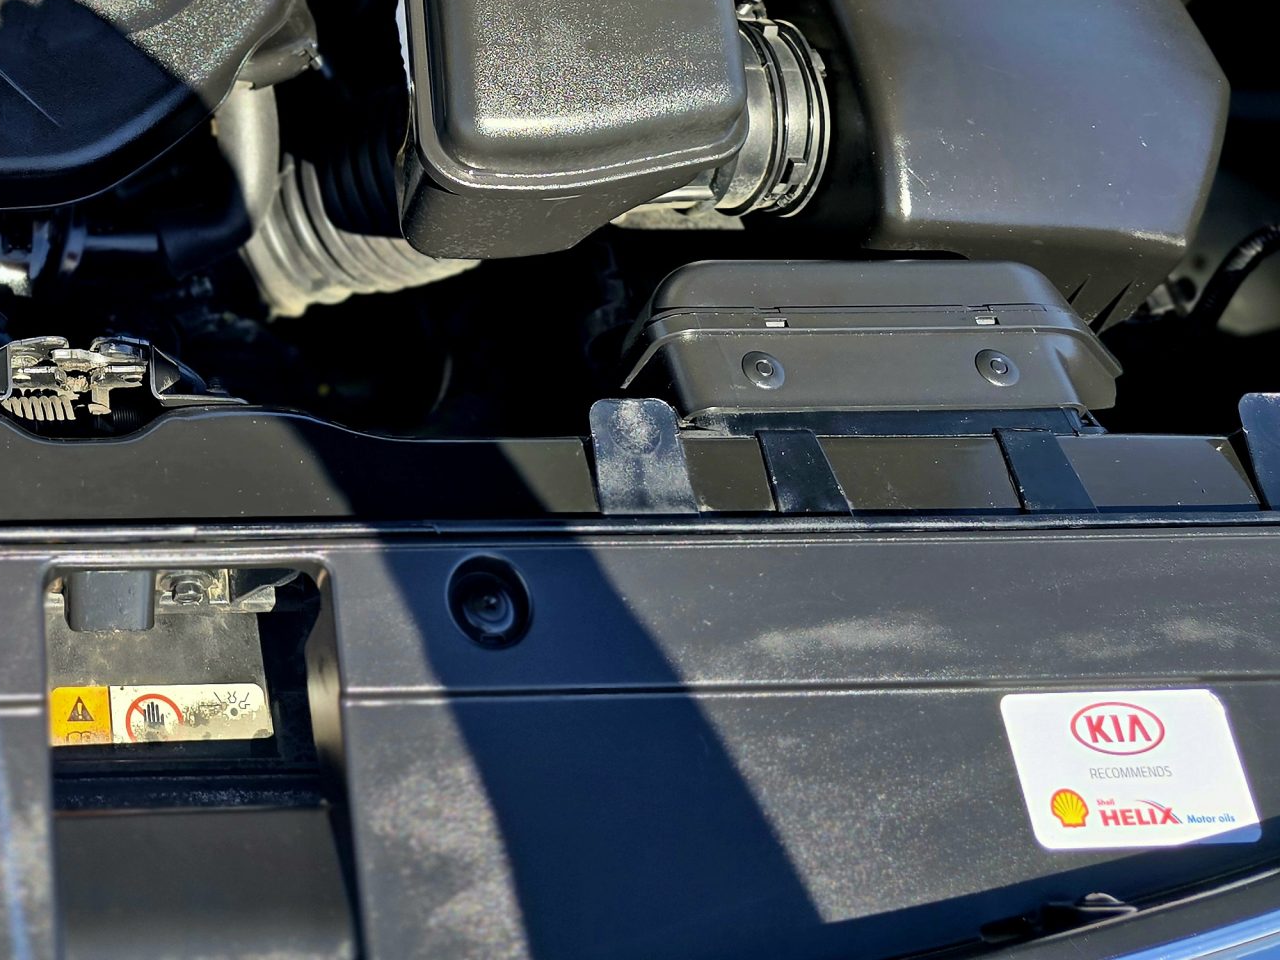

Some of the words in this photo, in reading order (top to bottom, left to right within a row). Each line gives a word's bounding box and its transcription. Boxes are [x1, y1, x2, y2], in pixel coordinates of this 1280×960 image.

[1083, 714, 1152, 743] KIA
[1089, 765, 1173, 780] RECOMMENDS
[1098, 807, 1182, 827] HELIX
[1187, 813, 1216, 824] Motor
[1218, 813, 1236, 824] oils
